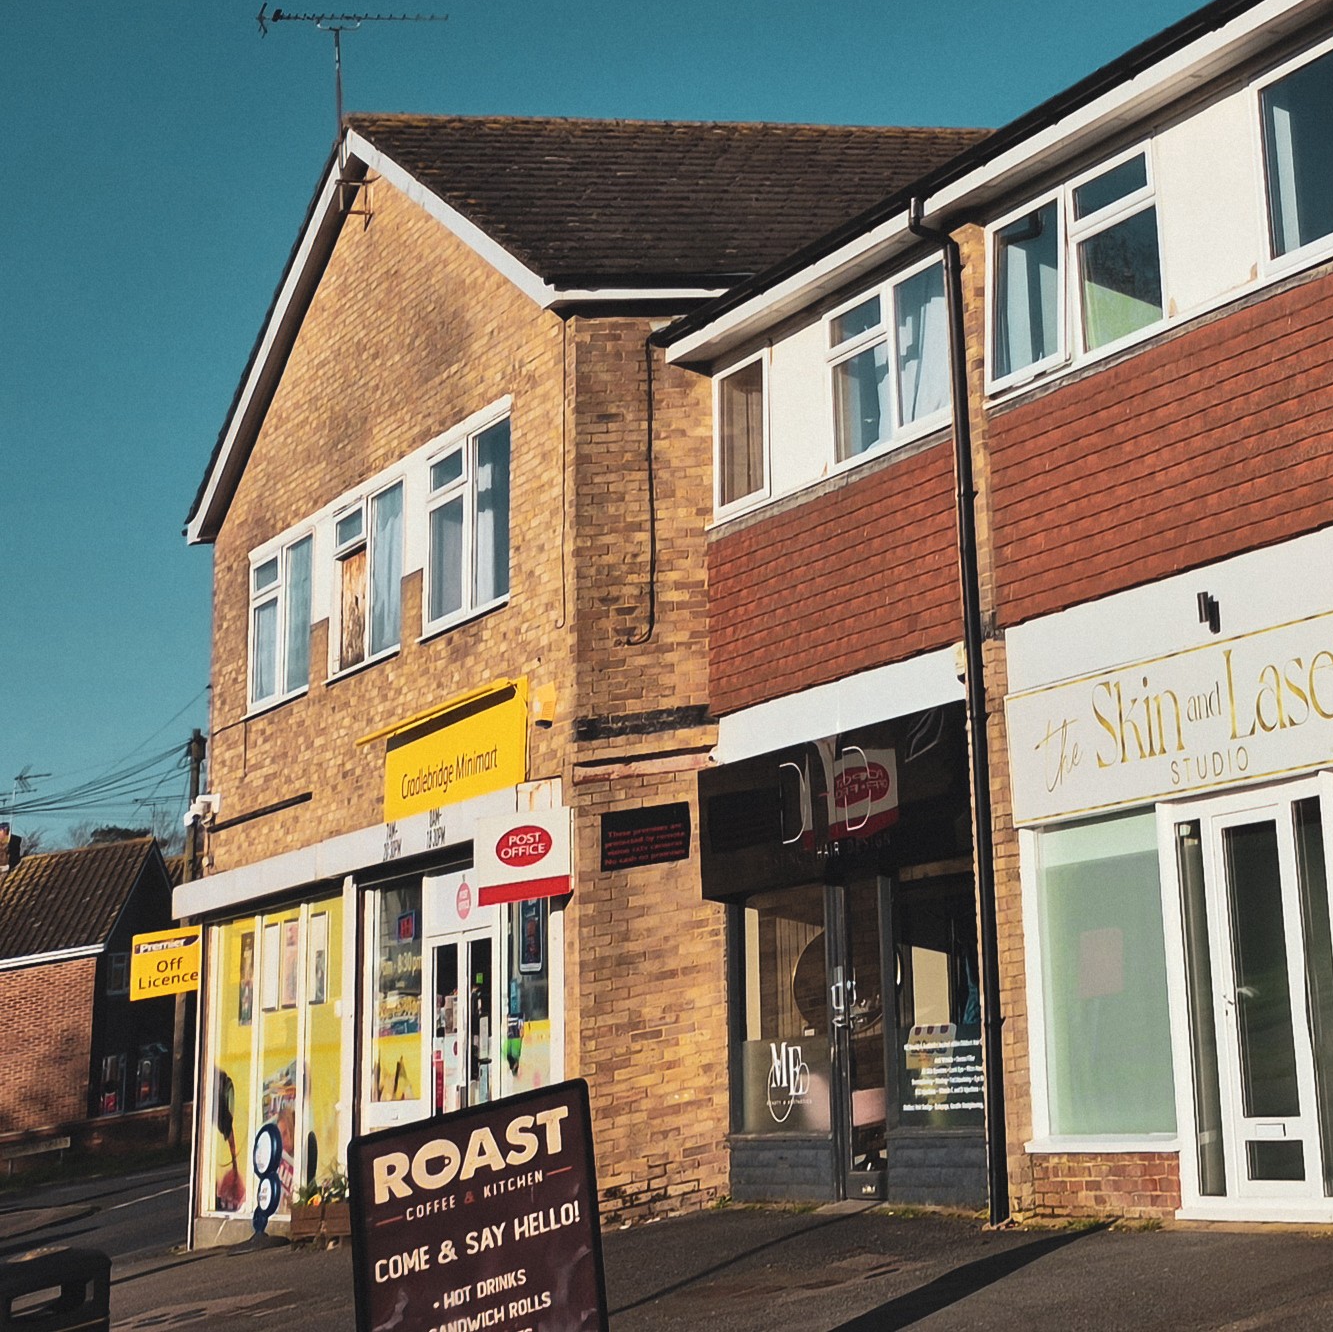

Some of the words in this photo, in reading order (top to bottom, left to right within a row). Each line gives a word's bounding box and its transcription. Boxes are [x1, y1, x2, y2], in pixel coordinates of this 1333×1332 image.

[1091, 676, 1186, 769] Skin
[1186, 681, 1222, 723] and
[401, 759, 454, 799] Cradlebridge
[455, 744, 498, 781] Minimart
[1034, 718, 1084, 793] the
[1171, 746, 1249, 786] STUDIO
[501, 843, 546, 859] OFFICE
[508, 832, 541, 846] POST
[816, 841, 840, 859] HAIR
[140, 939, 186, 953] Premier
[157, 957, 183, 973] Off
[138, 971, 199, 989] Licence
[373, 1105, 569, 1205] ROAST
[406, 1195, 456, 1221] COFFEE
[463, 1191, 475, 1204] &
[483, 1170, 544, 1198] KITCHEN
[375, 1246, 430, 1283] COME
[437, 1240, 458, 1265] &
[465, 1221, 507, 1255] SAY
[514, 1200, 581, 1241] HELLO!
[443, 1285, 472, 1310] HOT
[476, 1269, 527, 1299] DRINKS
[509, 1291, 551, 1324] ROLLS
